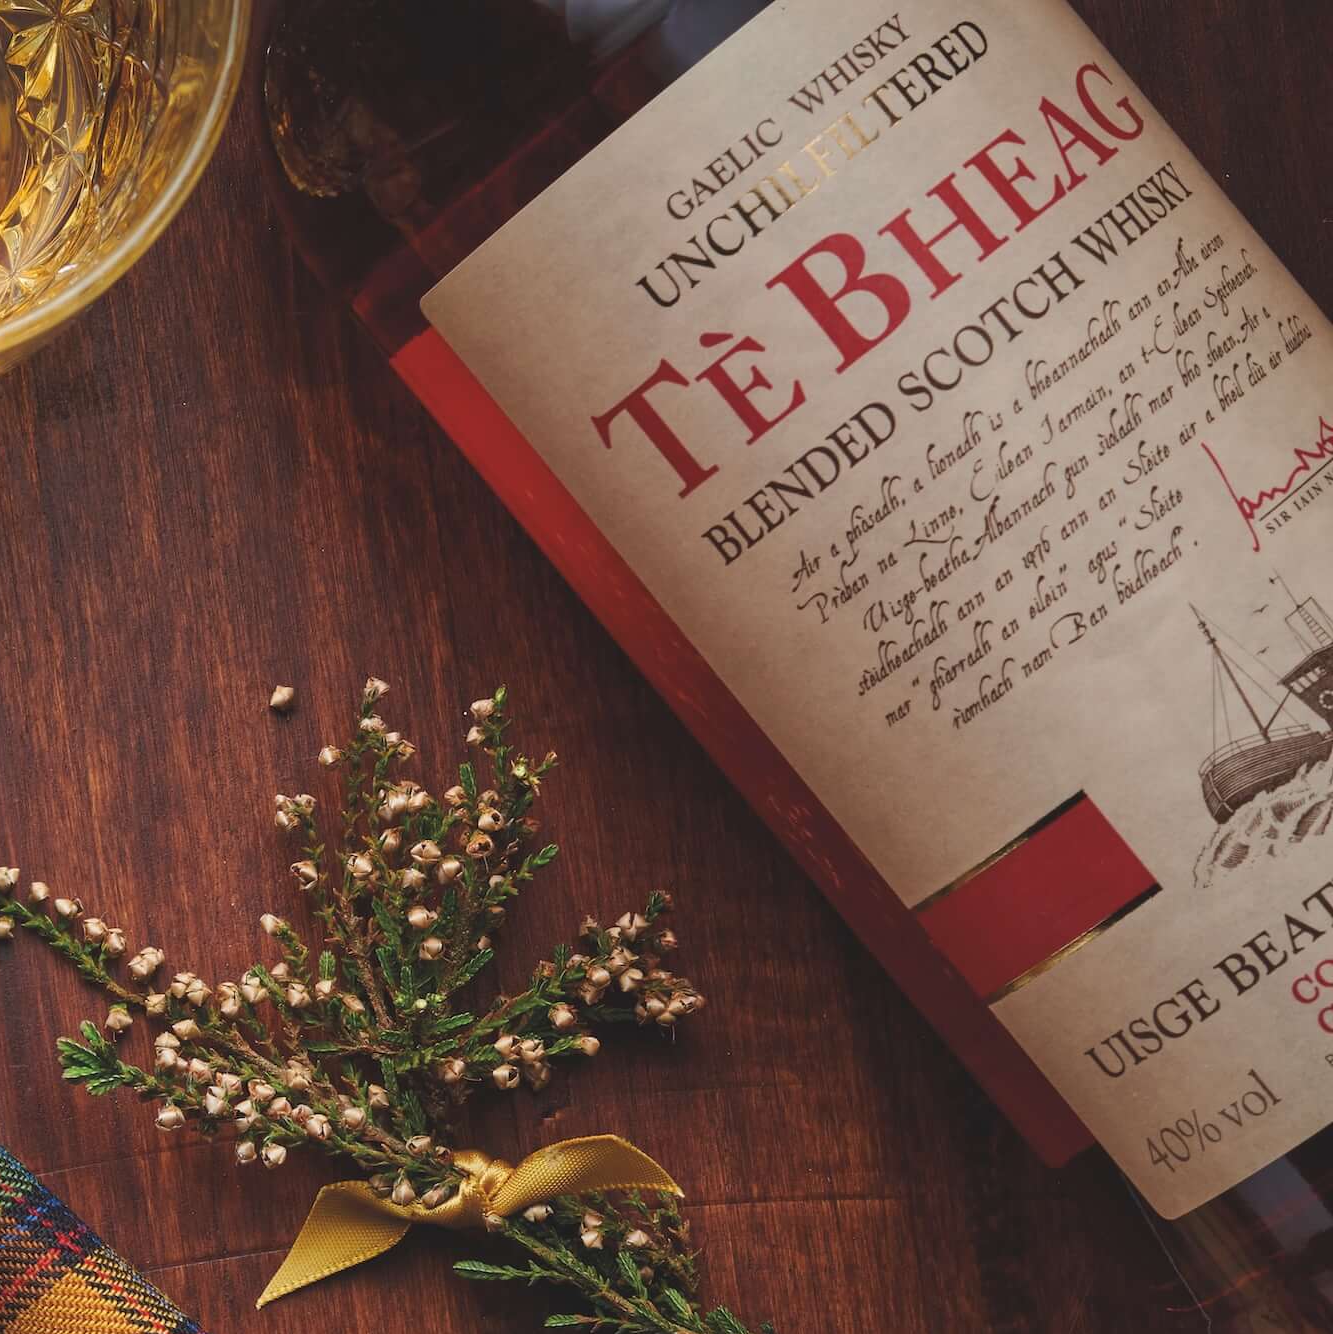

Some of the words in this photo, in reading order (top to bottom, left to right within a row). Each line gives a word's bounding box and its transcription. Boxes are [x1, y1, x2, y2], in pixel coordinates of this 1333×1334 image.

[666, 117, 784, 221] GAELIC
[786, 13, 911, 115] WHISKY
[590, 332, 807, 500] TÈ
[764, 62, 1144, 375] BHEAG
[700, 401, 897, 566] BLENDED
[896, 250, 1086, 413] SCOTCH
[1069, 161, 1193, 266] WHISKY
[791, 549, 822, 593] Air
[830, 543, 841, 558] a
[913, 477, 925, 494] a
[988, 412, 1004, 432] is
[1012, 398, 1024, 415] a
[1128, 294, 1152, 321] ann
[1156, 278, 1172, 297] an
[876, 551, 899, 575] na
[1118, 362, 1136, 385] an
[956, 591, 986, 622] ann
[994, 569, 1014, 592] an
[1021, 524, 1051, 570] 1976
[1060, 509, 1089, 541] ann
[1098, 487, 1117, 511] an
[1178, 421, 1197, 446] air
[1205, 409, 1216, 424] a
[1064, 455, 1090, 501] gun
[1147, 385, 1174, 415] mar
[1265, 510, 1293, 535] SIR
[1292, 482, 1323, 512] IAIN
[885, 699, 912, 728] mar
[1001, 618, 1020, 641] an
[1087, 540, 1118, 585] agus
[1020, 647, 1054, 679] nam
[1084, 977, 1222, 1078] UISGE
[1146, 1109, 1222, 1173] 40%
[1217, 1068, 1282, 1128] vol
